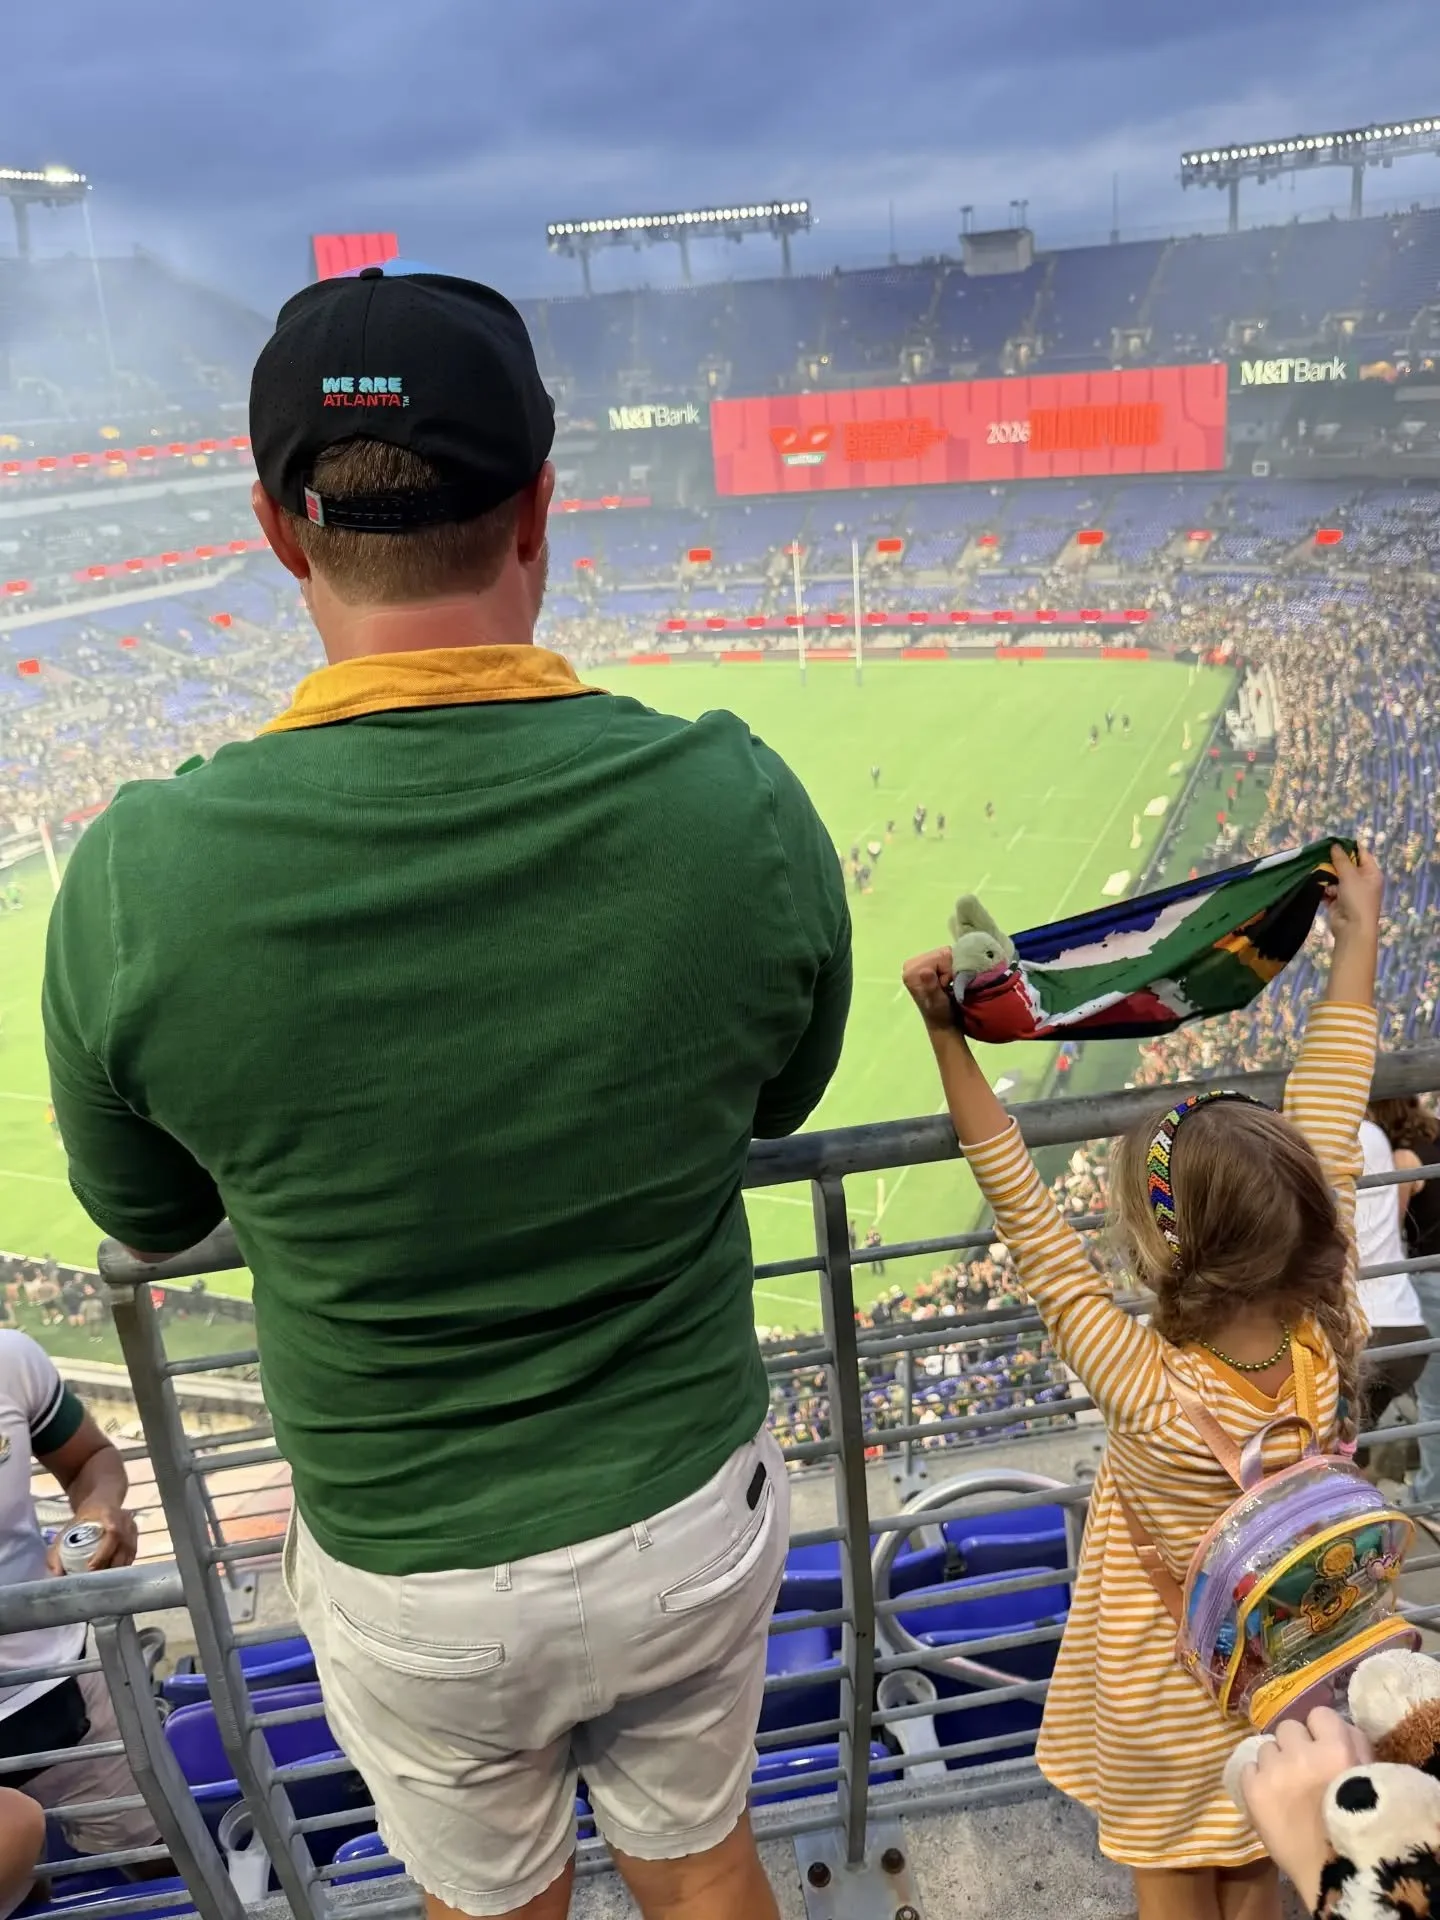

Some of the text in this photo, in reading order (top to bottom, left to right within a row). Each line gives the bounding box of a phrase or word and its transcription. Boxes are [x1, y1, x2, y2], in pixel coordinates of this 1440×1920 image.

[322, 377, 402, 393] WE ARE
[323, 394, 401, 407] ATLANTA
[986, 422, 1031, 444] 2026
